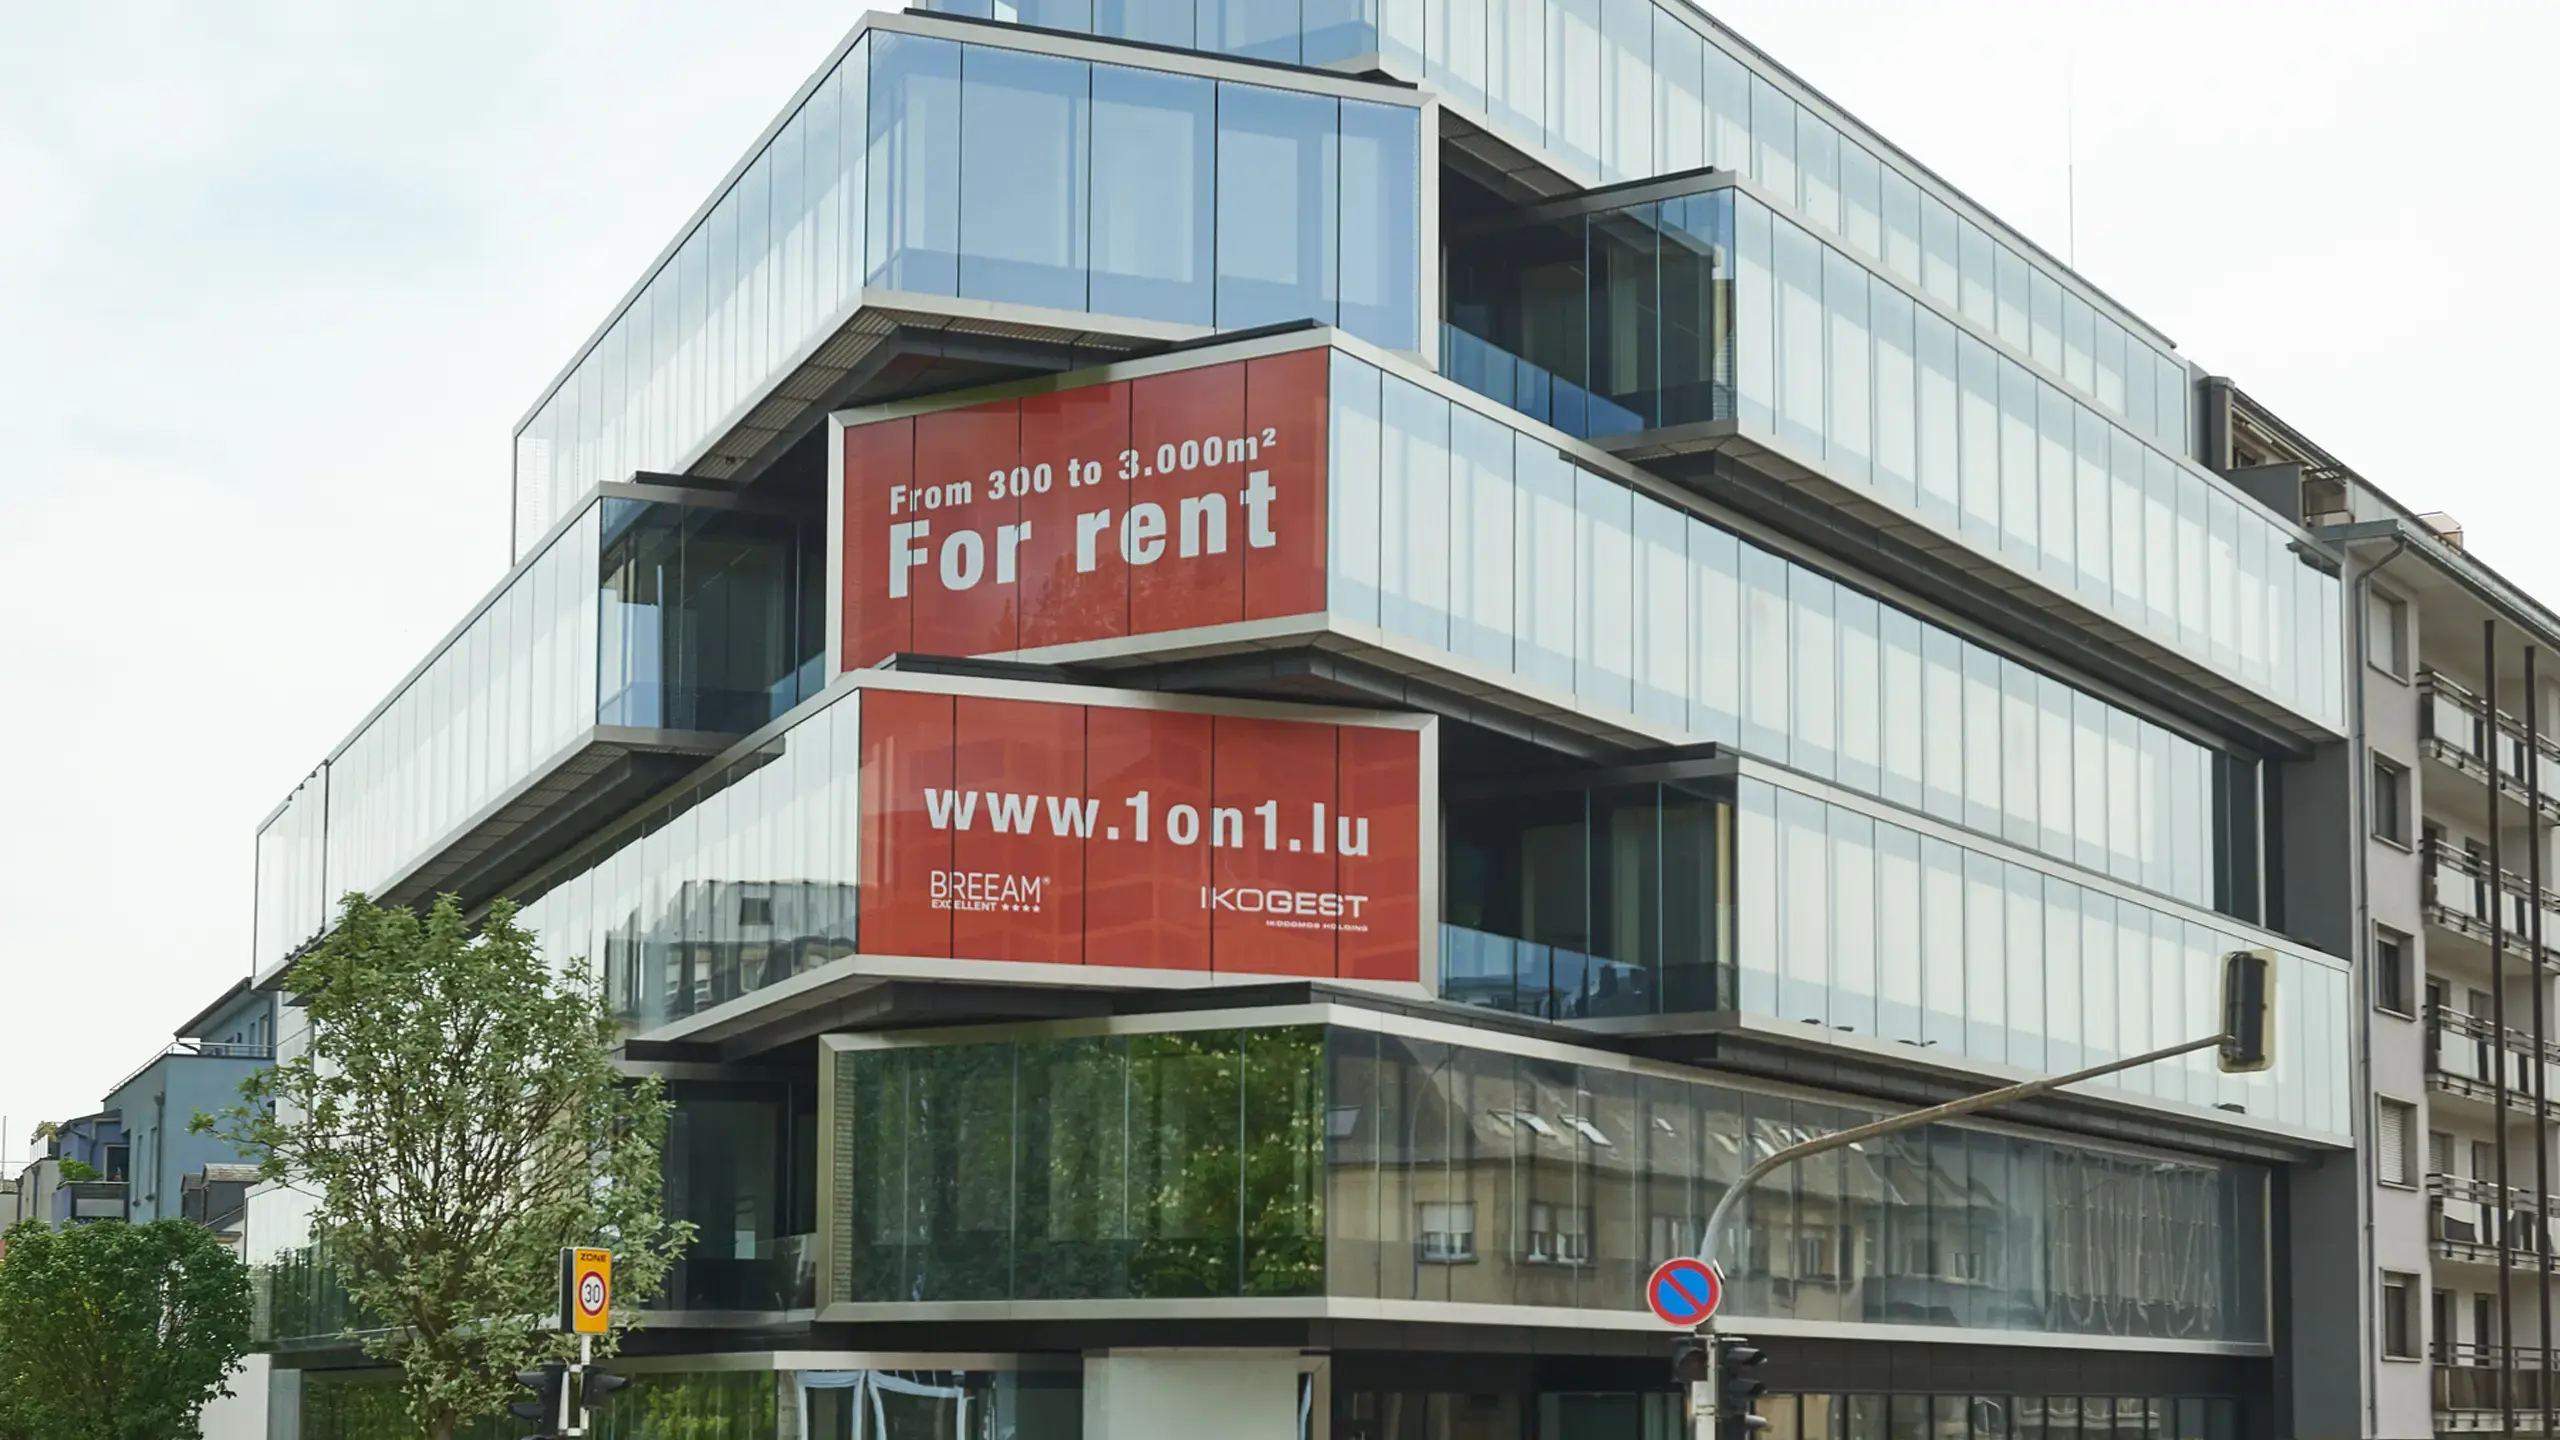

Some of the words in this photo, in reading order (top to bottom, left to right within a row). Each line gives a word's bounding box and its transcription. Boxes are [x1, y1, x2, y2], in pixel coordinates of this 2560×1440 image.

[889, 479, 973, 515] From
[988, 463, 1053, 500] 300
[1068, 457, 1102, 487] to
[889, 519, 1032, 599] For
[1075, 469, 1277, 573] rent
[924, 787, 1369, 857] www.1on1.lu
[931, 899, 997, 911] EXCELLENT
[1201, 886, 1369, 918] IKOGEST
[580, 1252, 607, 1263] ZONE
[584, 1283, 601, 1304] 30
